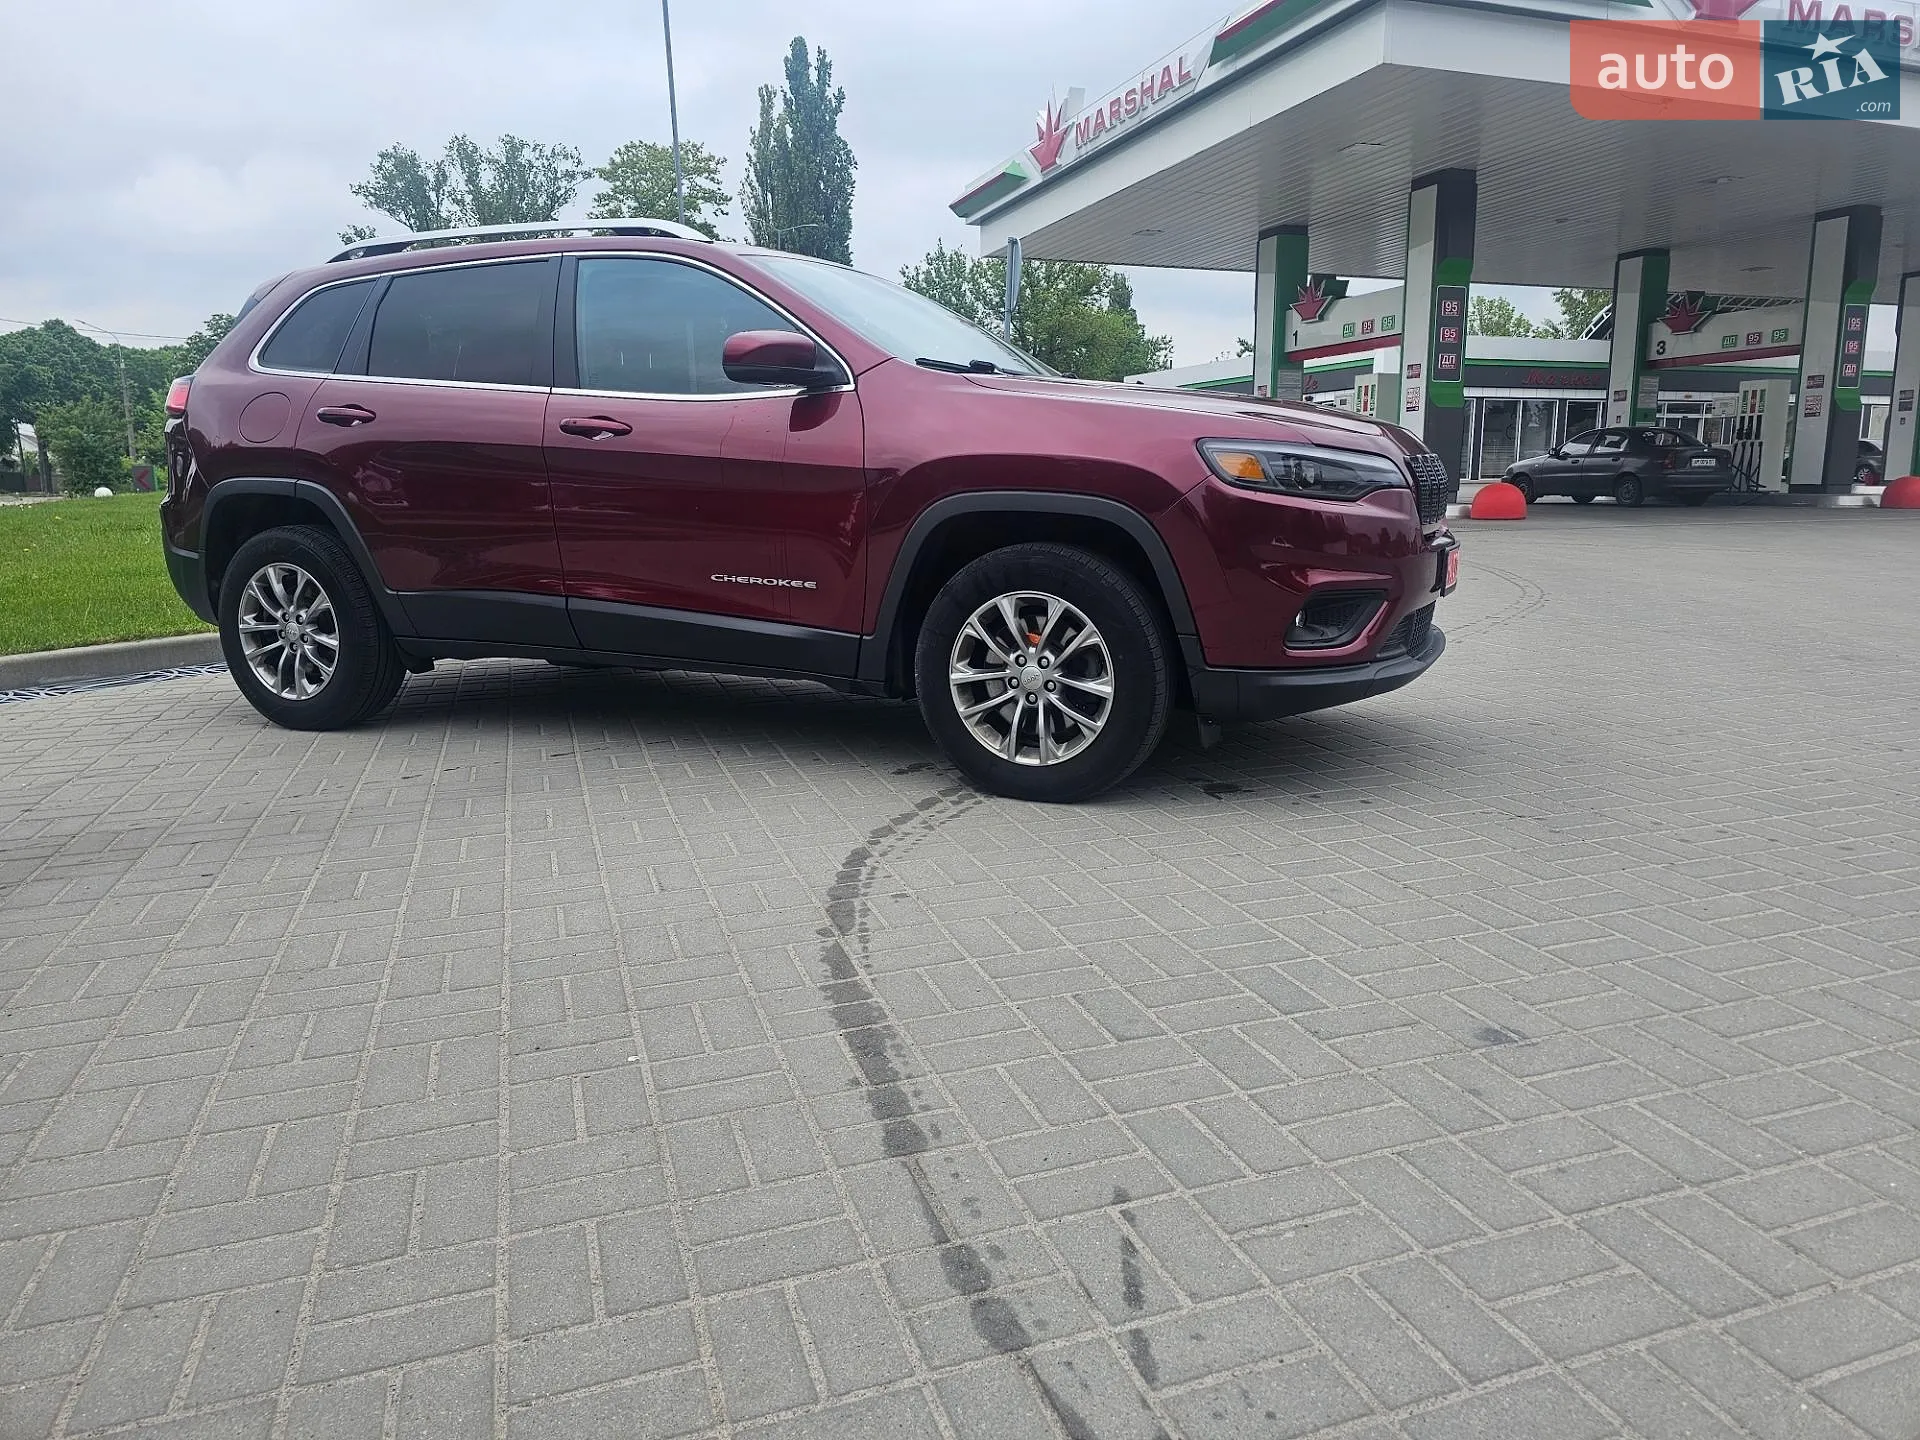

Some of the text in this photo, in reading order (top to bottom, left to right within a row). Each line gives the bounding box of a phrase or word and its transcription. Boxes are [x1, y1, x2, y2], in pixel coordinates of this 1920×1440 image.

[1075, 56, 1192, 147] MARSHAL
[1445, 301, 1458, 312] 95
[1363, 321, 1372, 331] 95
[1383, 317, 1393, 328] 95
[1292, 329, 1298, 347] 1
[1444, 328, 1456, 338] 95
[1748, 333, 1760, 344] 95
[1773, 329, 1785, 340] 95
[1656, 340, 1666, 355] 3
[1441, 355, 1455, 365] ДП
[710, 574, 817, 589] CHEROKEE
